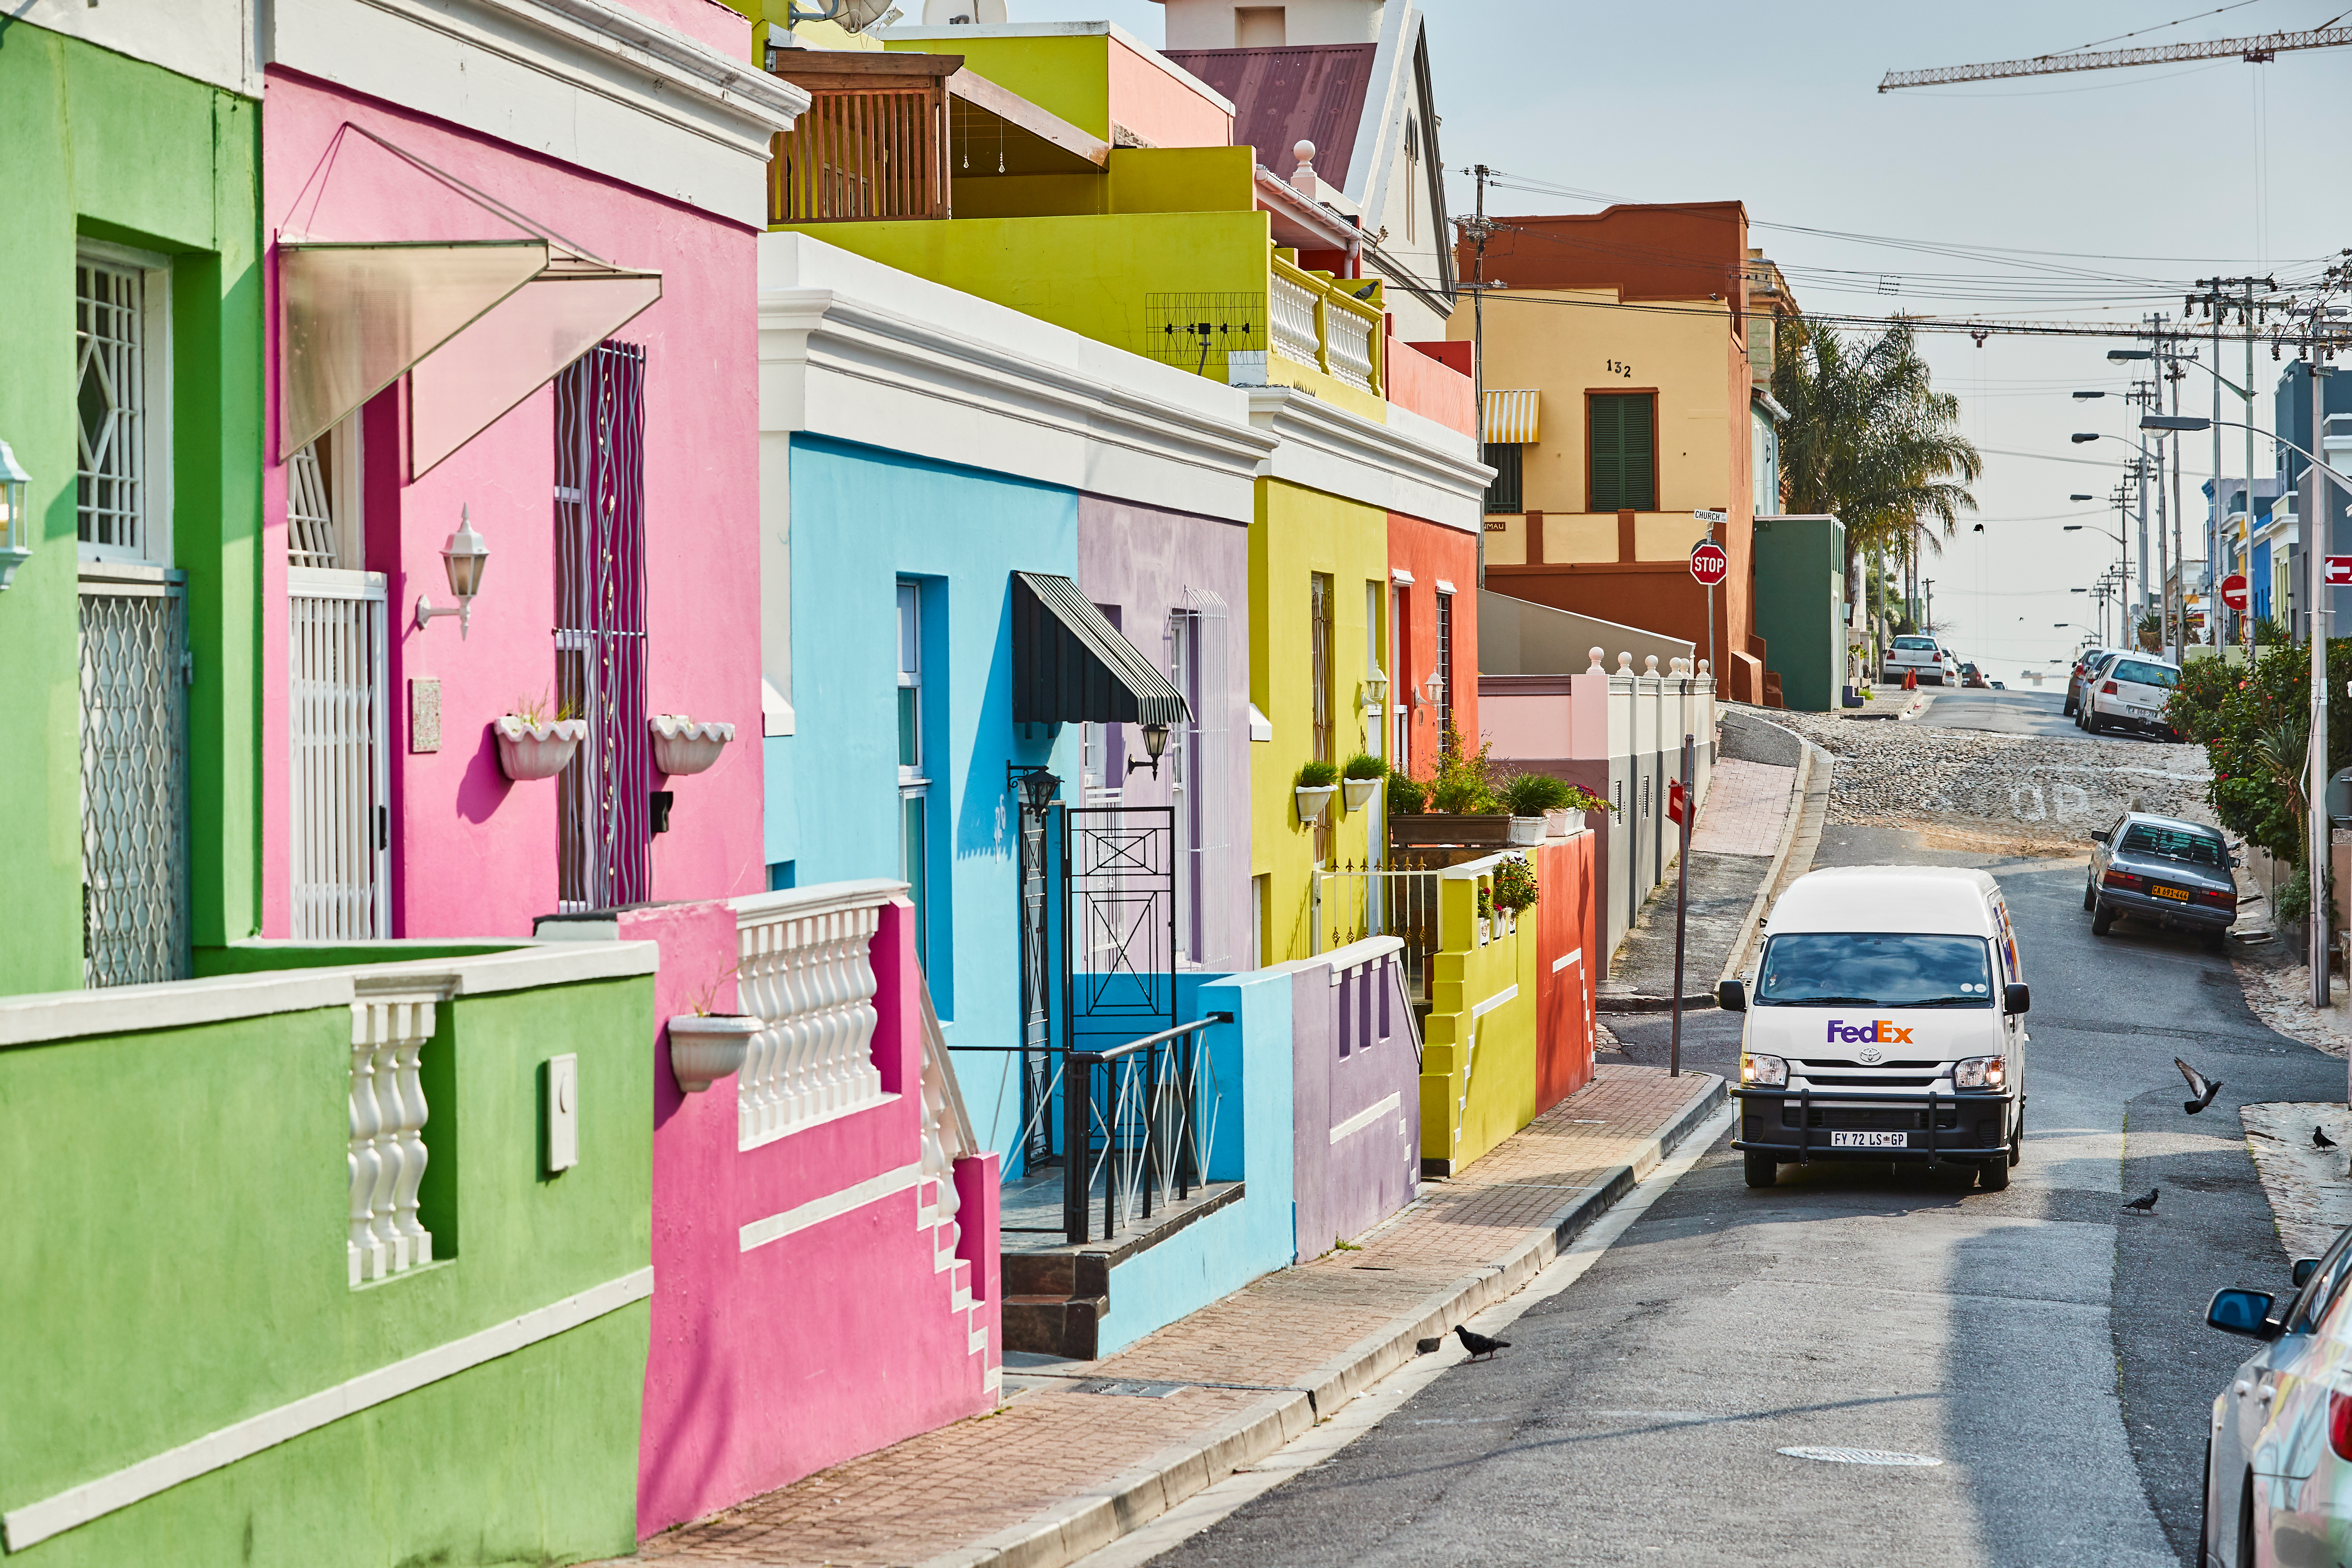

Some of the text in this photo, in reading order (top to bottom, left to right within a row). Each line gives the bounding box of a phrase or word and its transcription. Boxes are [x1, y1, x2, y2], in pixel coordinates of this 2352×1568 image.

[1607, 359, 1631, 378] 132
[1695, 511, 1720, 521] CHURCH
[1695, 557, 1724, 573] STOP
[2153, 886, 2187, 900] CA 691-444
[1827, 1020, 1914, 1044] FedEx
[1835, 1133, 1904, 1145] FY 72 LS GP
